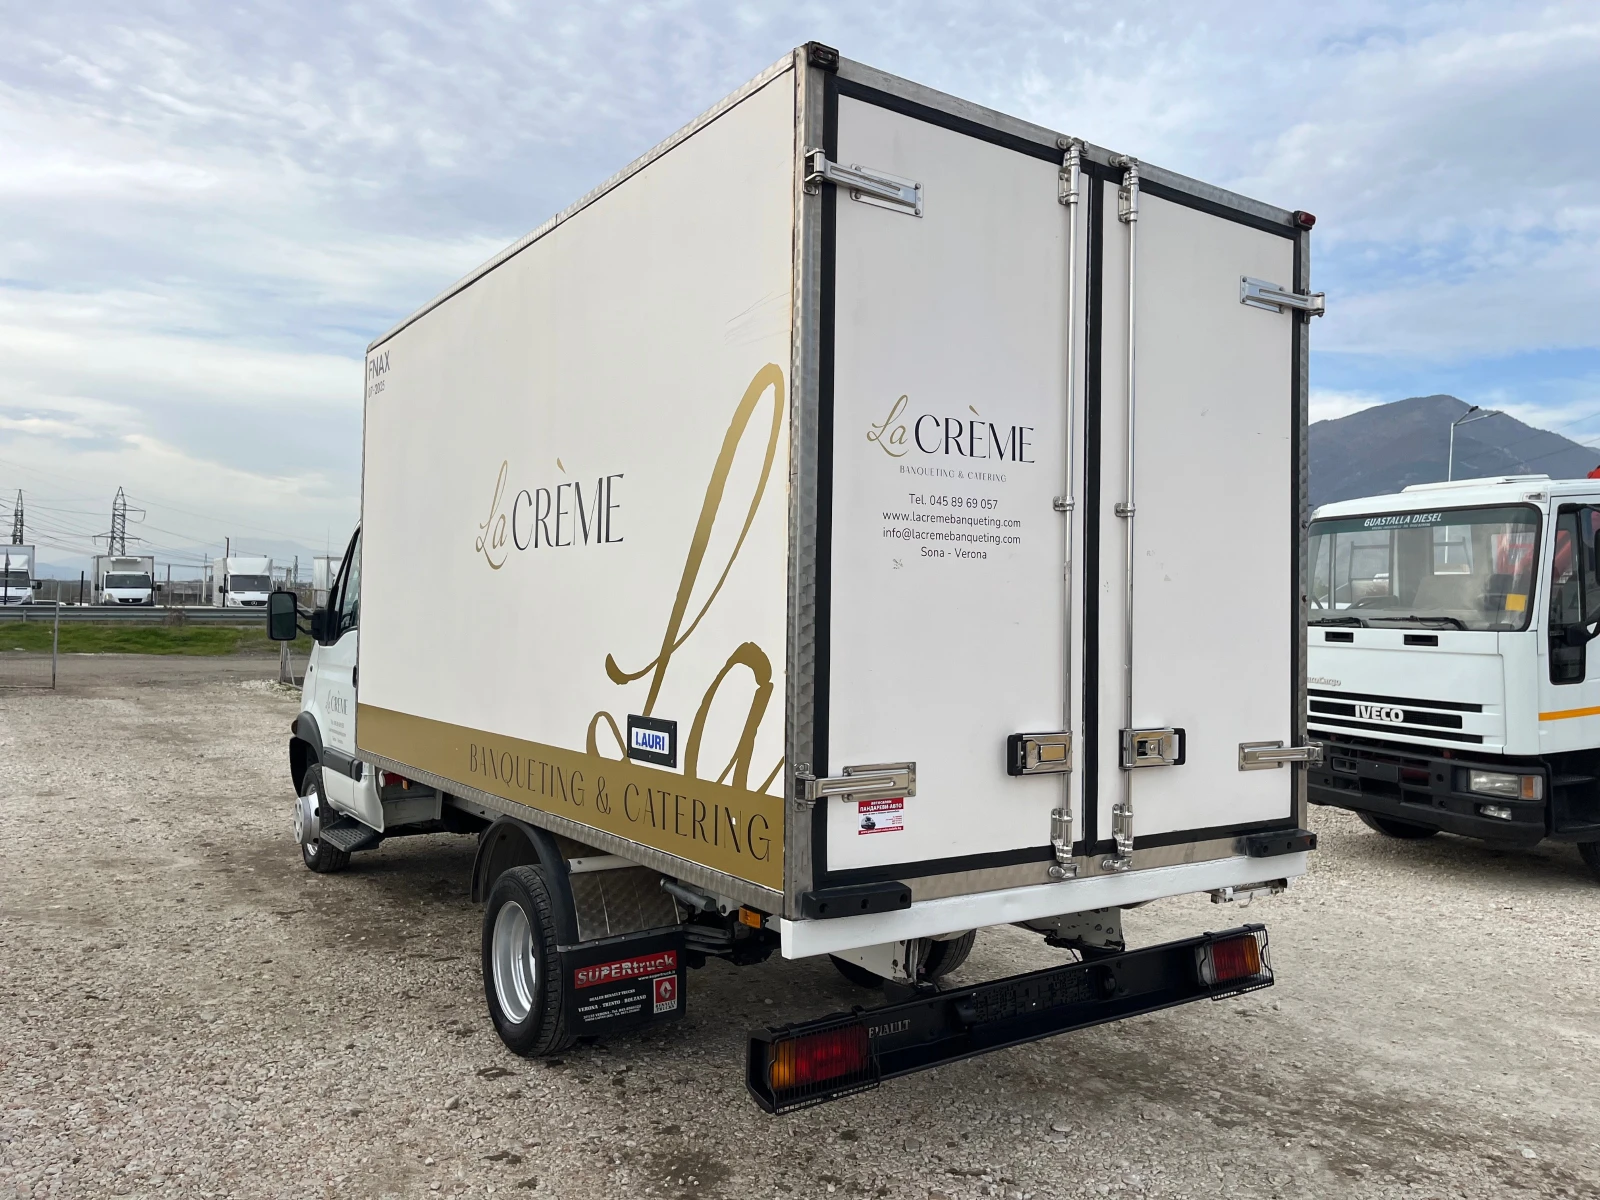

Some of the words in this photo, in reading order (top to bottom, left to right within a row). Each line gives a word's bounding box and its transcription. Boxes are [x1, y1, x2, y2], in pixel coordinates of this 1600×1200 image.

[368, 350, 390, 381] FNAX
[866, 394, 909, 458] La
[914, 404, 1035, 463] CRÈME
[899, 465, 955, 479] BANQUETING
[957, 470, 965, 479] &
[967, 471, 1007, 482] CATERING
[512, 457, 624, 551] CRÈME
[909, 493, 927, 505] Tel.
[930, 495, 948, 507] 045
[951, 496, 963, 508] 89
[966, 498, 978, 509] 69
[980, 499, 998, 510] 057
[882, 511, 1021, 529] www.lacremebanqueting.com
[1364, 515, 1411, 527] GUASTALLA
[1412, 512, 1442, 523] DIESEL
[883, 527, 1021, 546] info@lacremebanqueting.com
[920, 546, 945, 558] Sona
[954, 548, 988, 559] Verona
[1354, 705, 1404, 722] IVECO
[635, 731, 665, 751] LAURI
[469, 743, 585, 807] BANQUETING
[595, 776, 611, 815] &
[623, 783, 771, 862] CATERING
